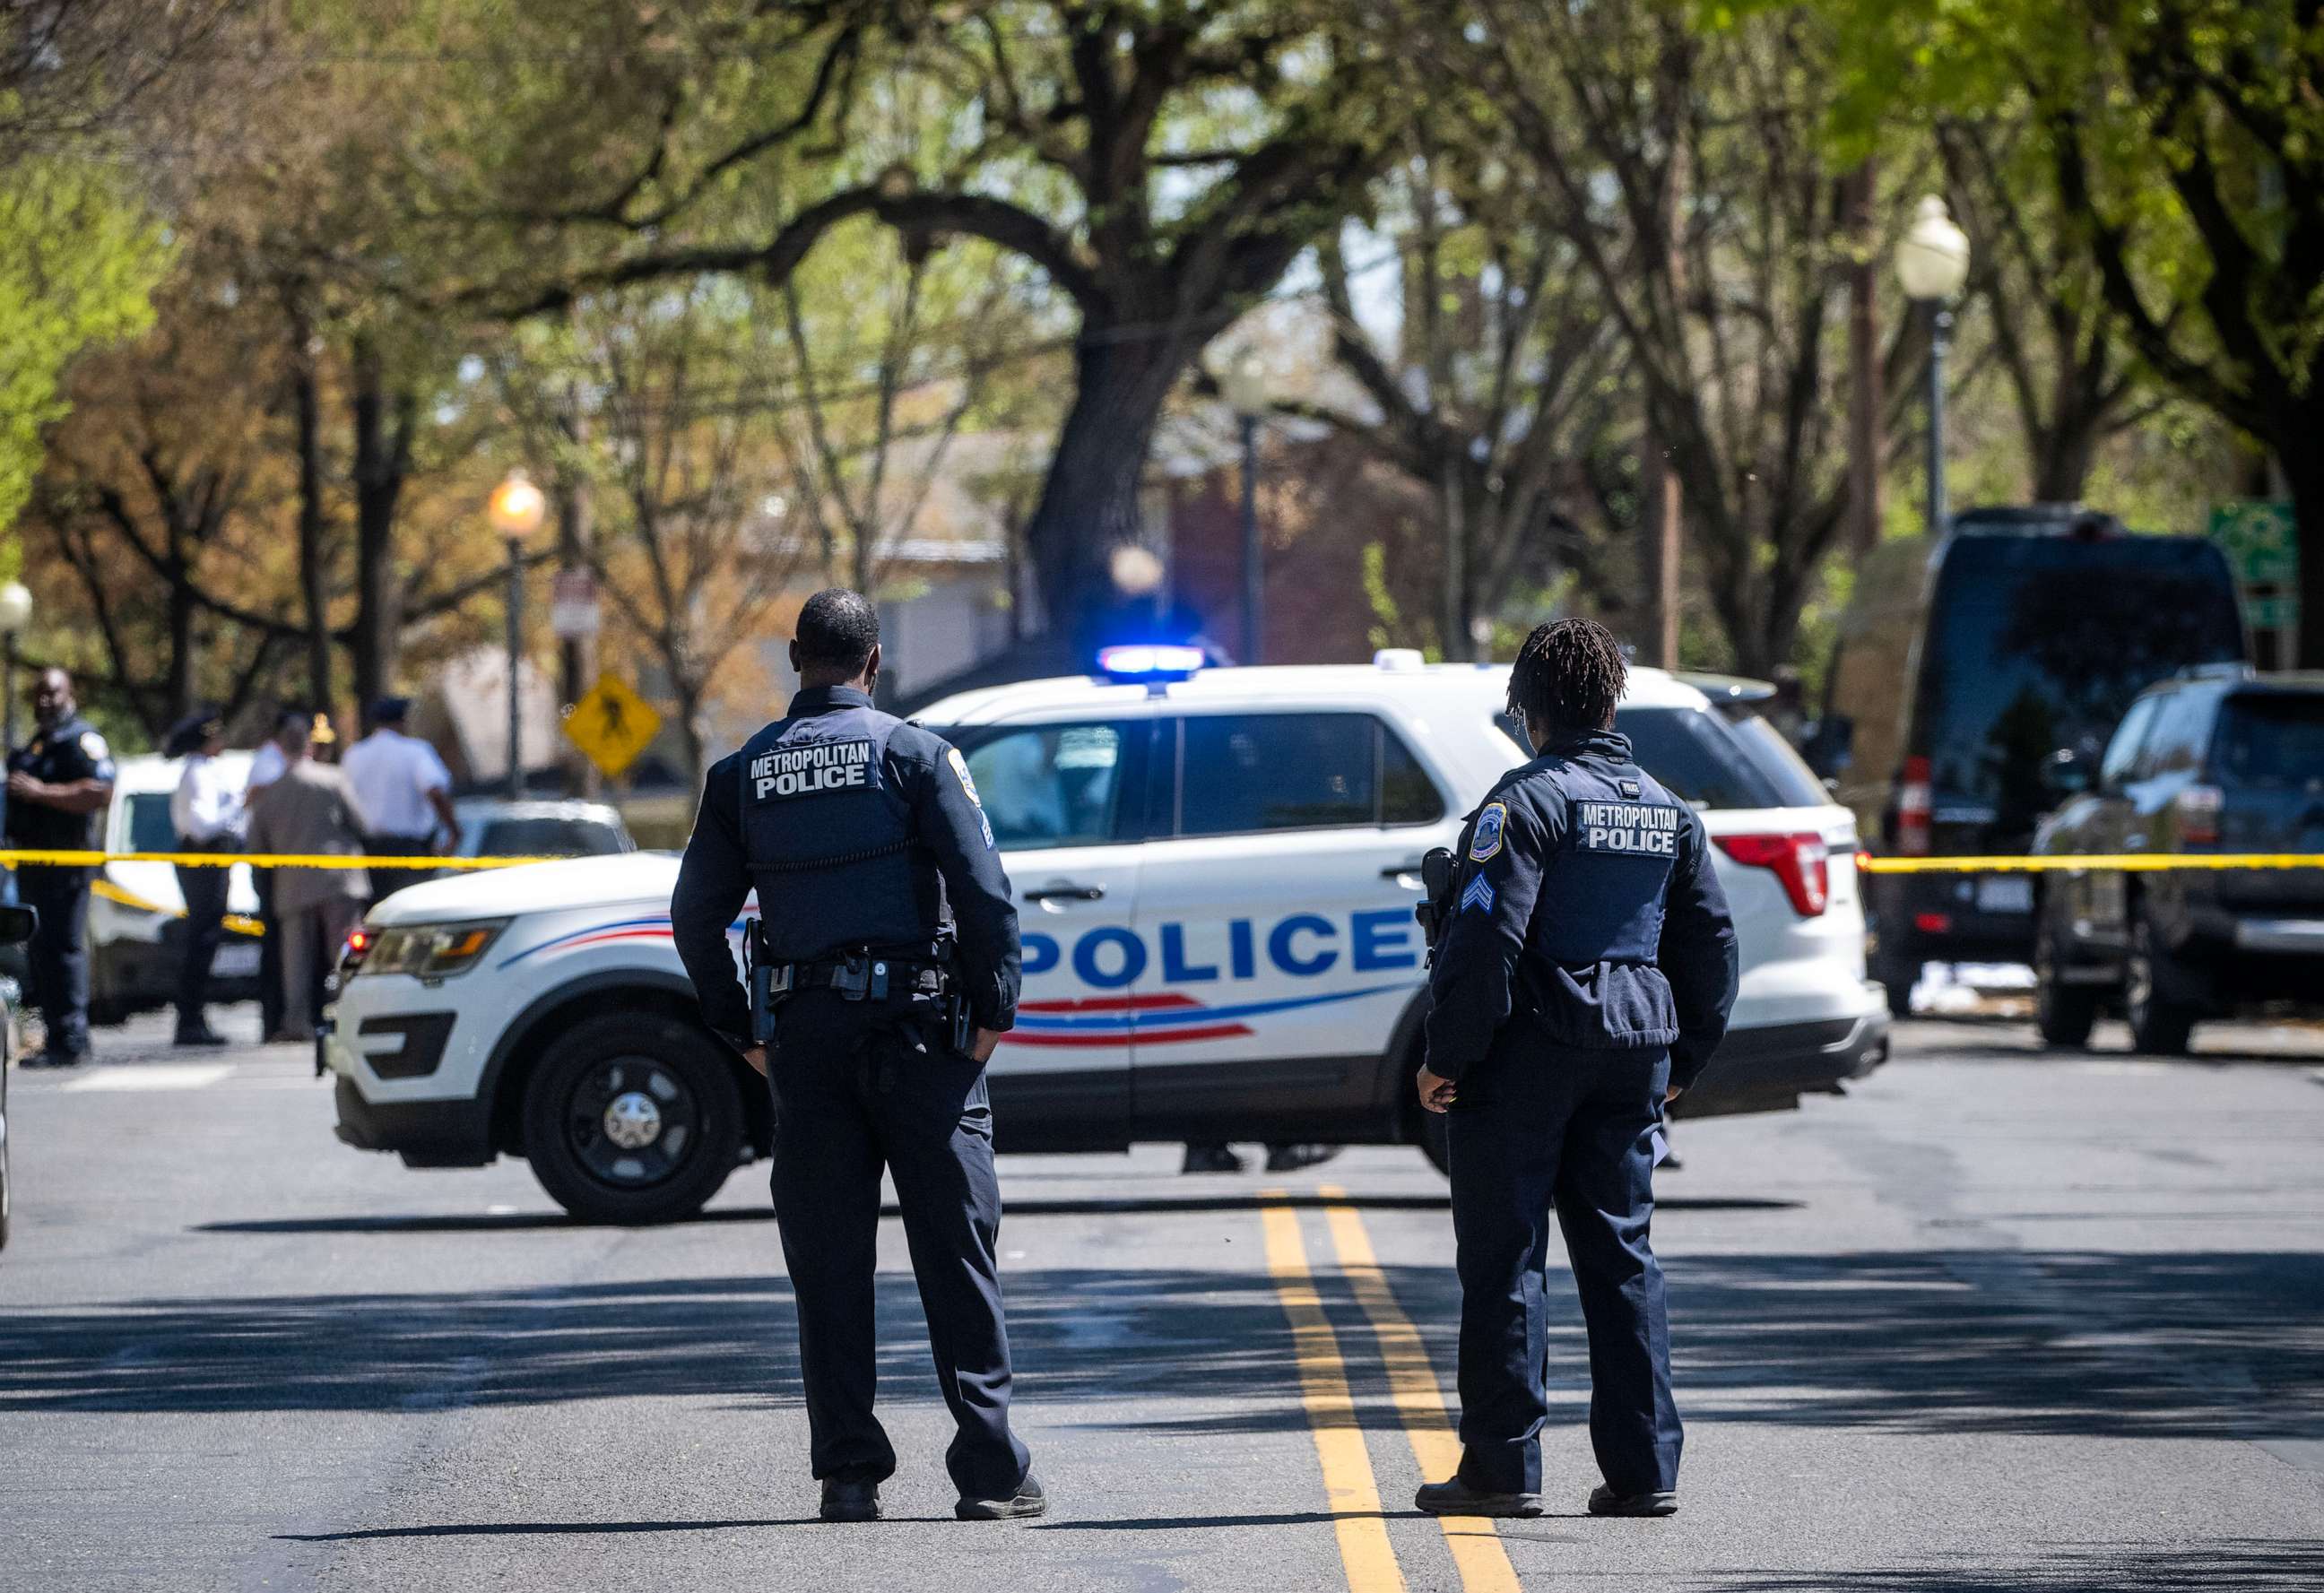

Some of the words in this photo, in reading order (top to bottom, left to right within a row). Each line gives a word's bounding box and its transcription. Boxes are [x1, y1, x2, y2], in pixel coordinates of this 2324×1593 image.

[750, 742, 870, 779] METROPOLITAN
[756, 764, 865, 800] POLICE
[1583, 804, 1678, 831] METROPOLITAN
[1589, 827, 1674, 853] POLICE
